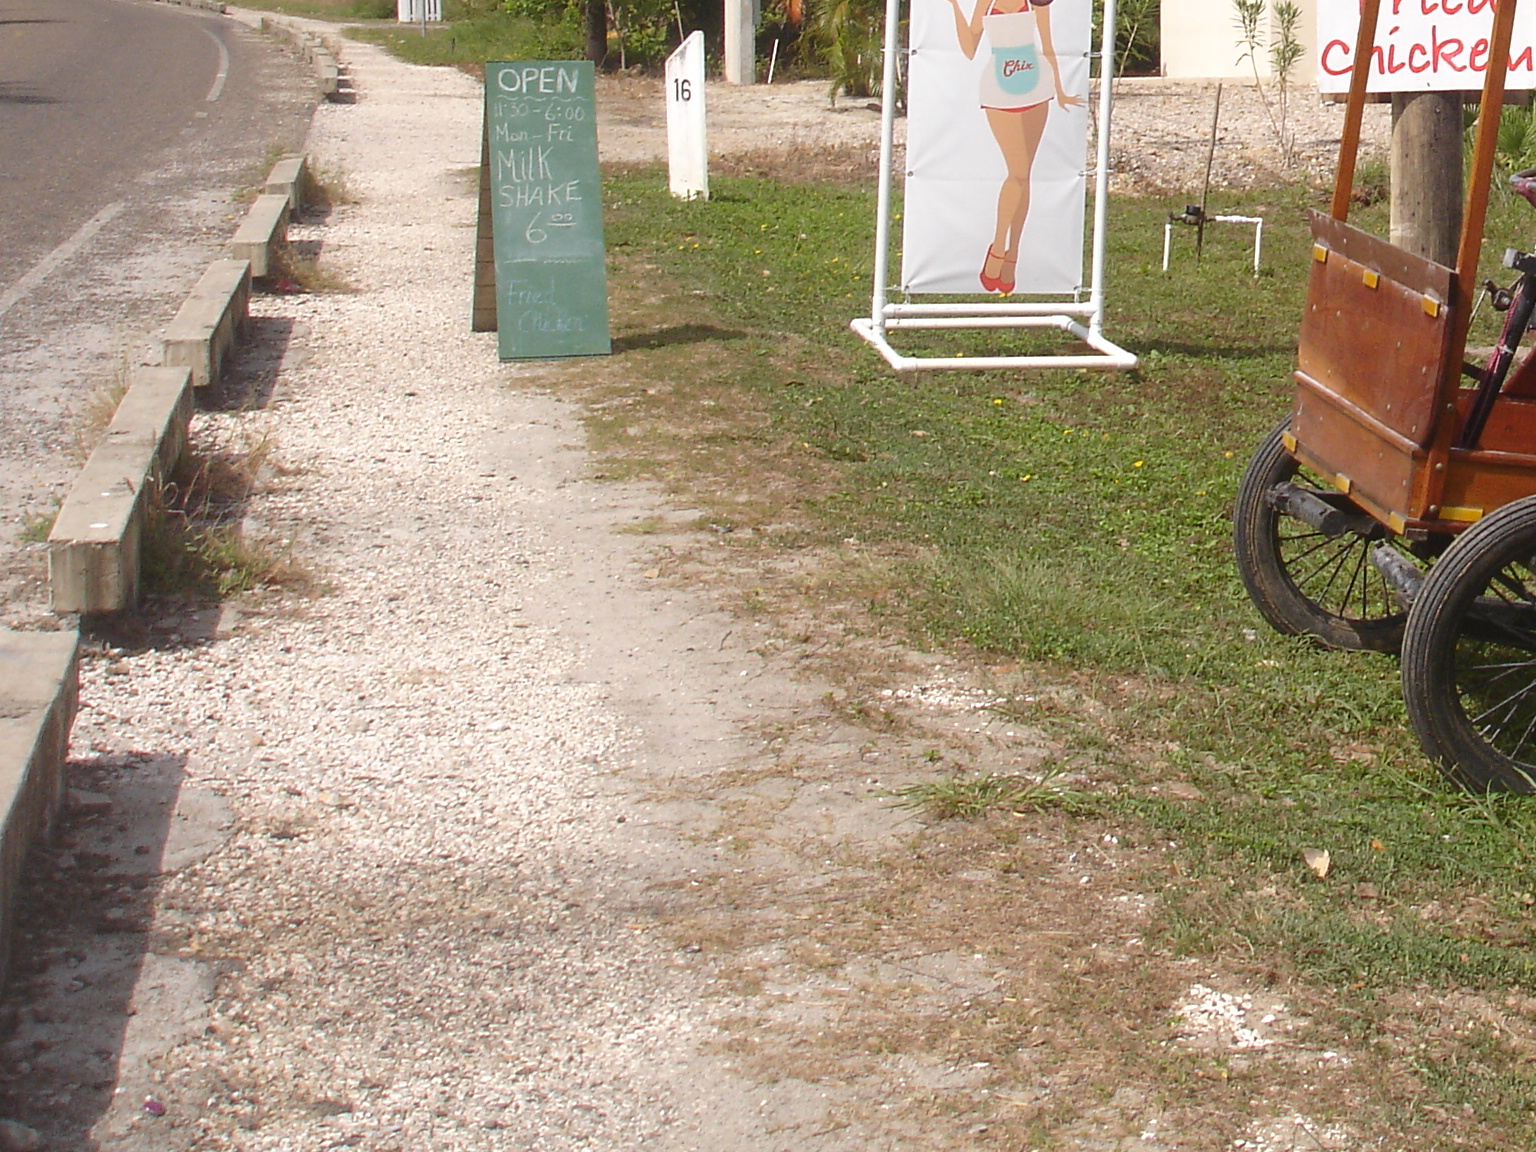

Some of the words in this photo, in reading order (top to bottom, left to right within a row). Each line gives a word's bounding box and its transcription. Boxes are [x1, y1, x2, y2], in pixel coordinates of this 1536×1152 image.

[498, 67, 579, 93] OPEN
[1003, 59, 1034, 77] Chix
[674, 78, 692, 102] 16
[500, 180, 582, 207] SHAKE
